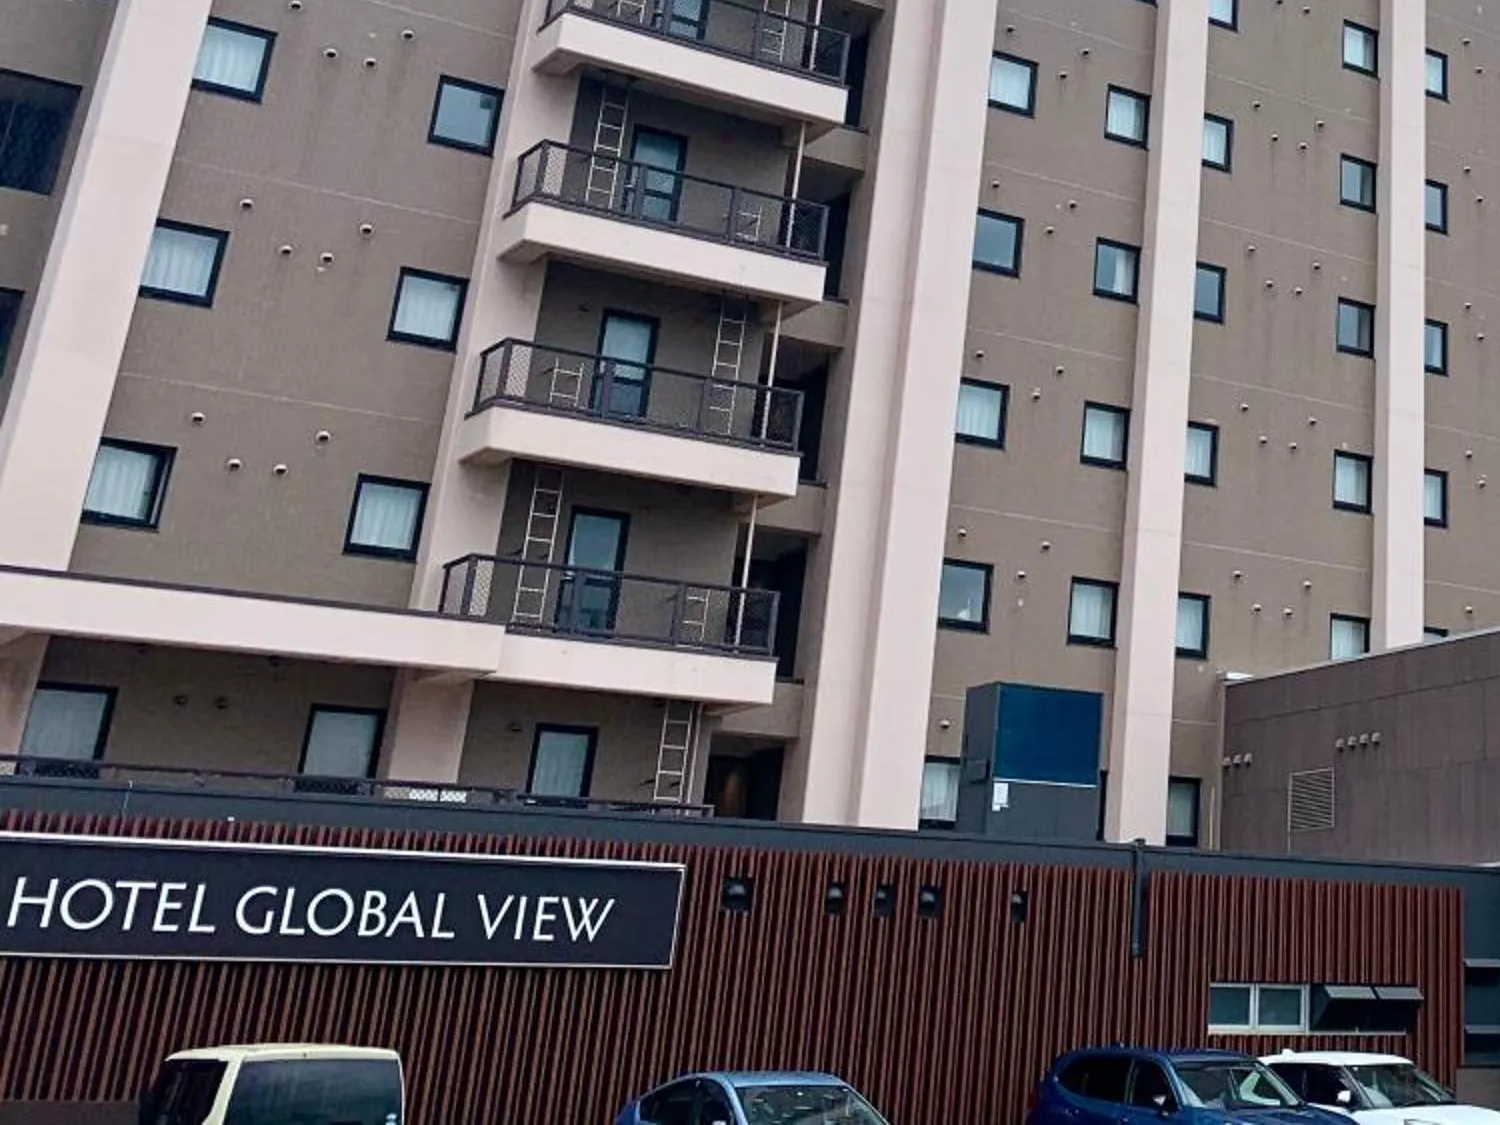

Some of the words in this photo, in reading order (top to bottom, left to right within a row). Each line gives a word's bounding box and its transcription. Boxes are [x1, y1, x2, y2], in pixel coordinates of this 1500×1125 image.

[7, 876, 217, 935] HOTEL
[234, 884, 455, 940] GLOBAL
[476, 893, 615, 943] VIEW
